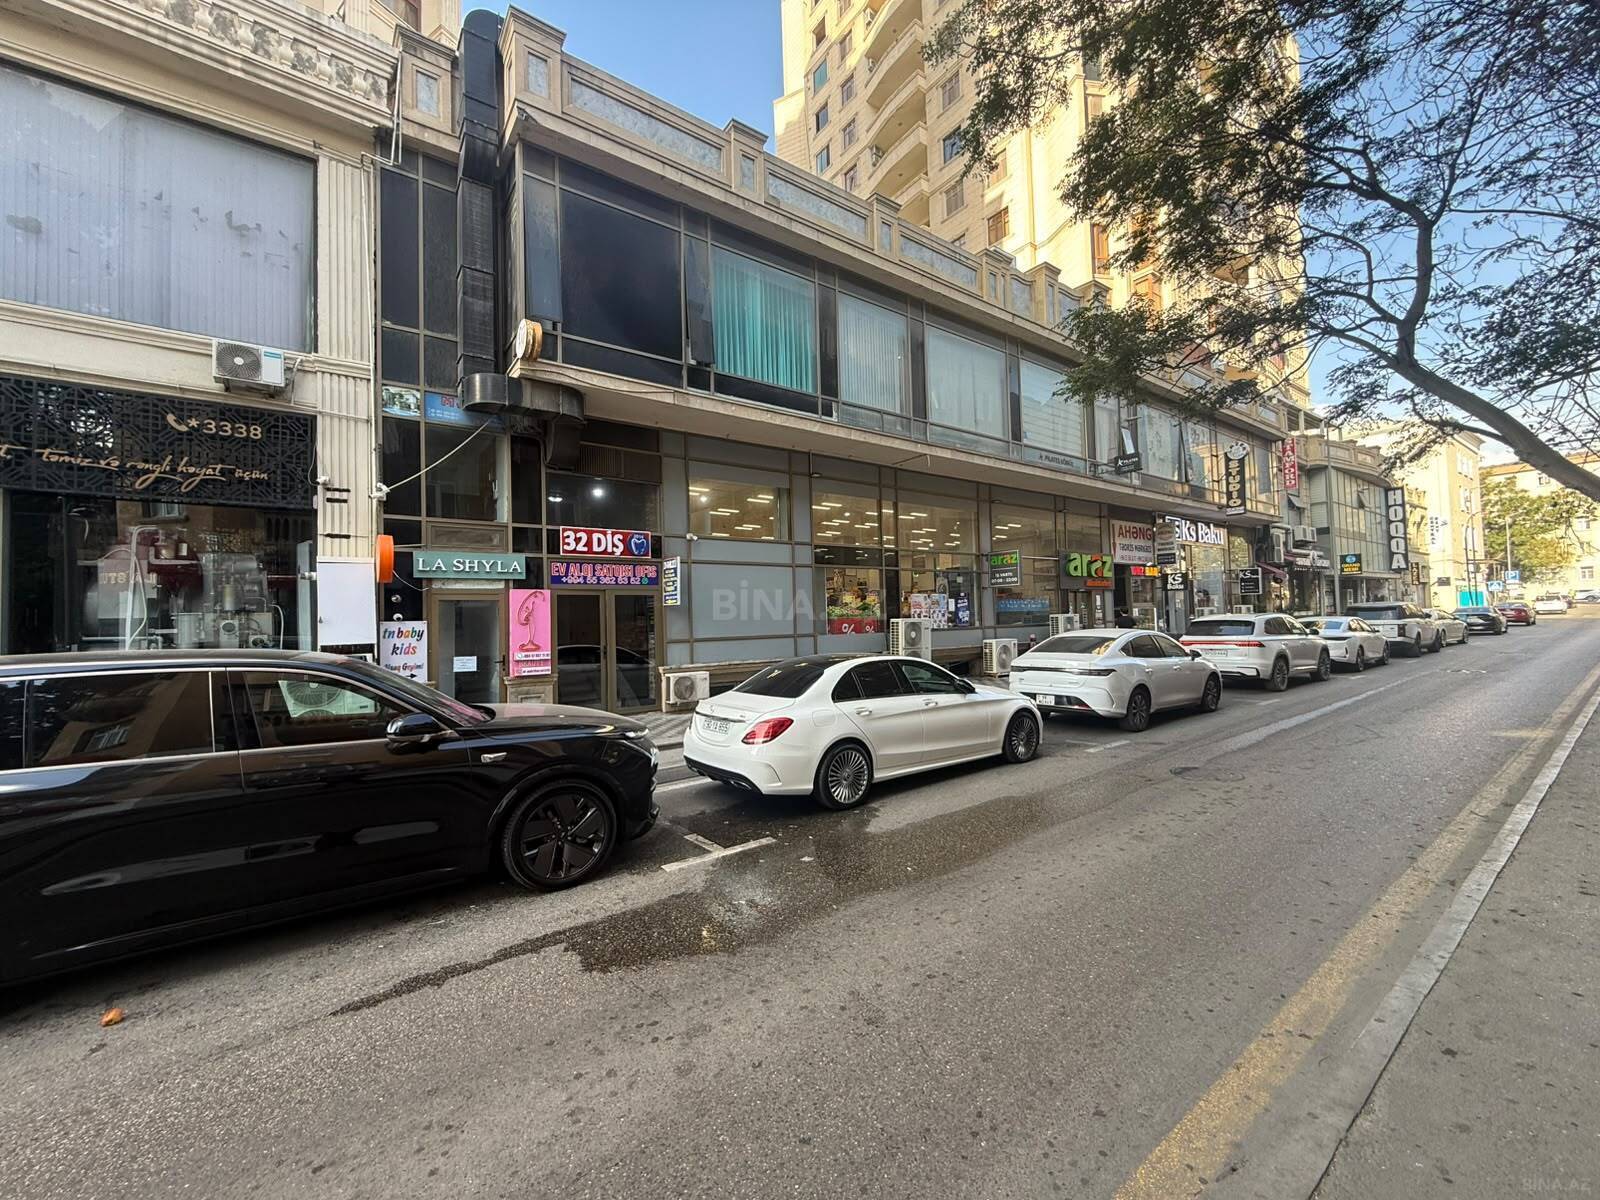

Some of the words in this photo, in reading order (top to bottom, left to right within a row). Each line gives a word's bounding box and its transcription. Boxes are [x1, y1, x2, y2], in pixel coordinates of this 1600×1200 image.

[1228, 460, 1242, 507] STUDIO
[1118, 524, 1152, 541] AHƏNG
[1182, 520, 1196, 541] Ks
[1198, 522, 1224, 545] Baku
[1387, 488, 1407, 569] HOQQA
[563, 530, 588, 552] 32
[592, 530, 624, 556] DİŞ
[417, 557, 447, 571] LA
[452, 558, 521, 573] SHYLA
[990, 551, 1018, 566] araz
[1067, 552, 1113, 578] araz
[551, 562, 566, 576] EV
[1167, 573, 1183, 585] KS
[396, 626, 424, 641] baby
[391, 643, 417, 656] kids
